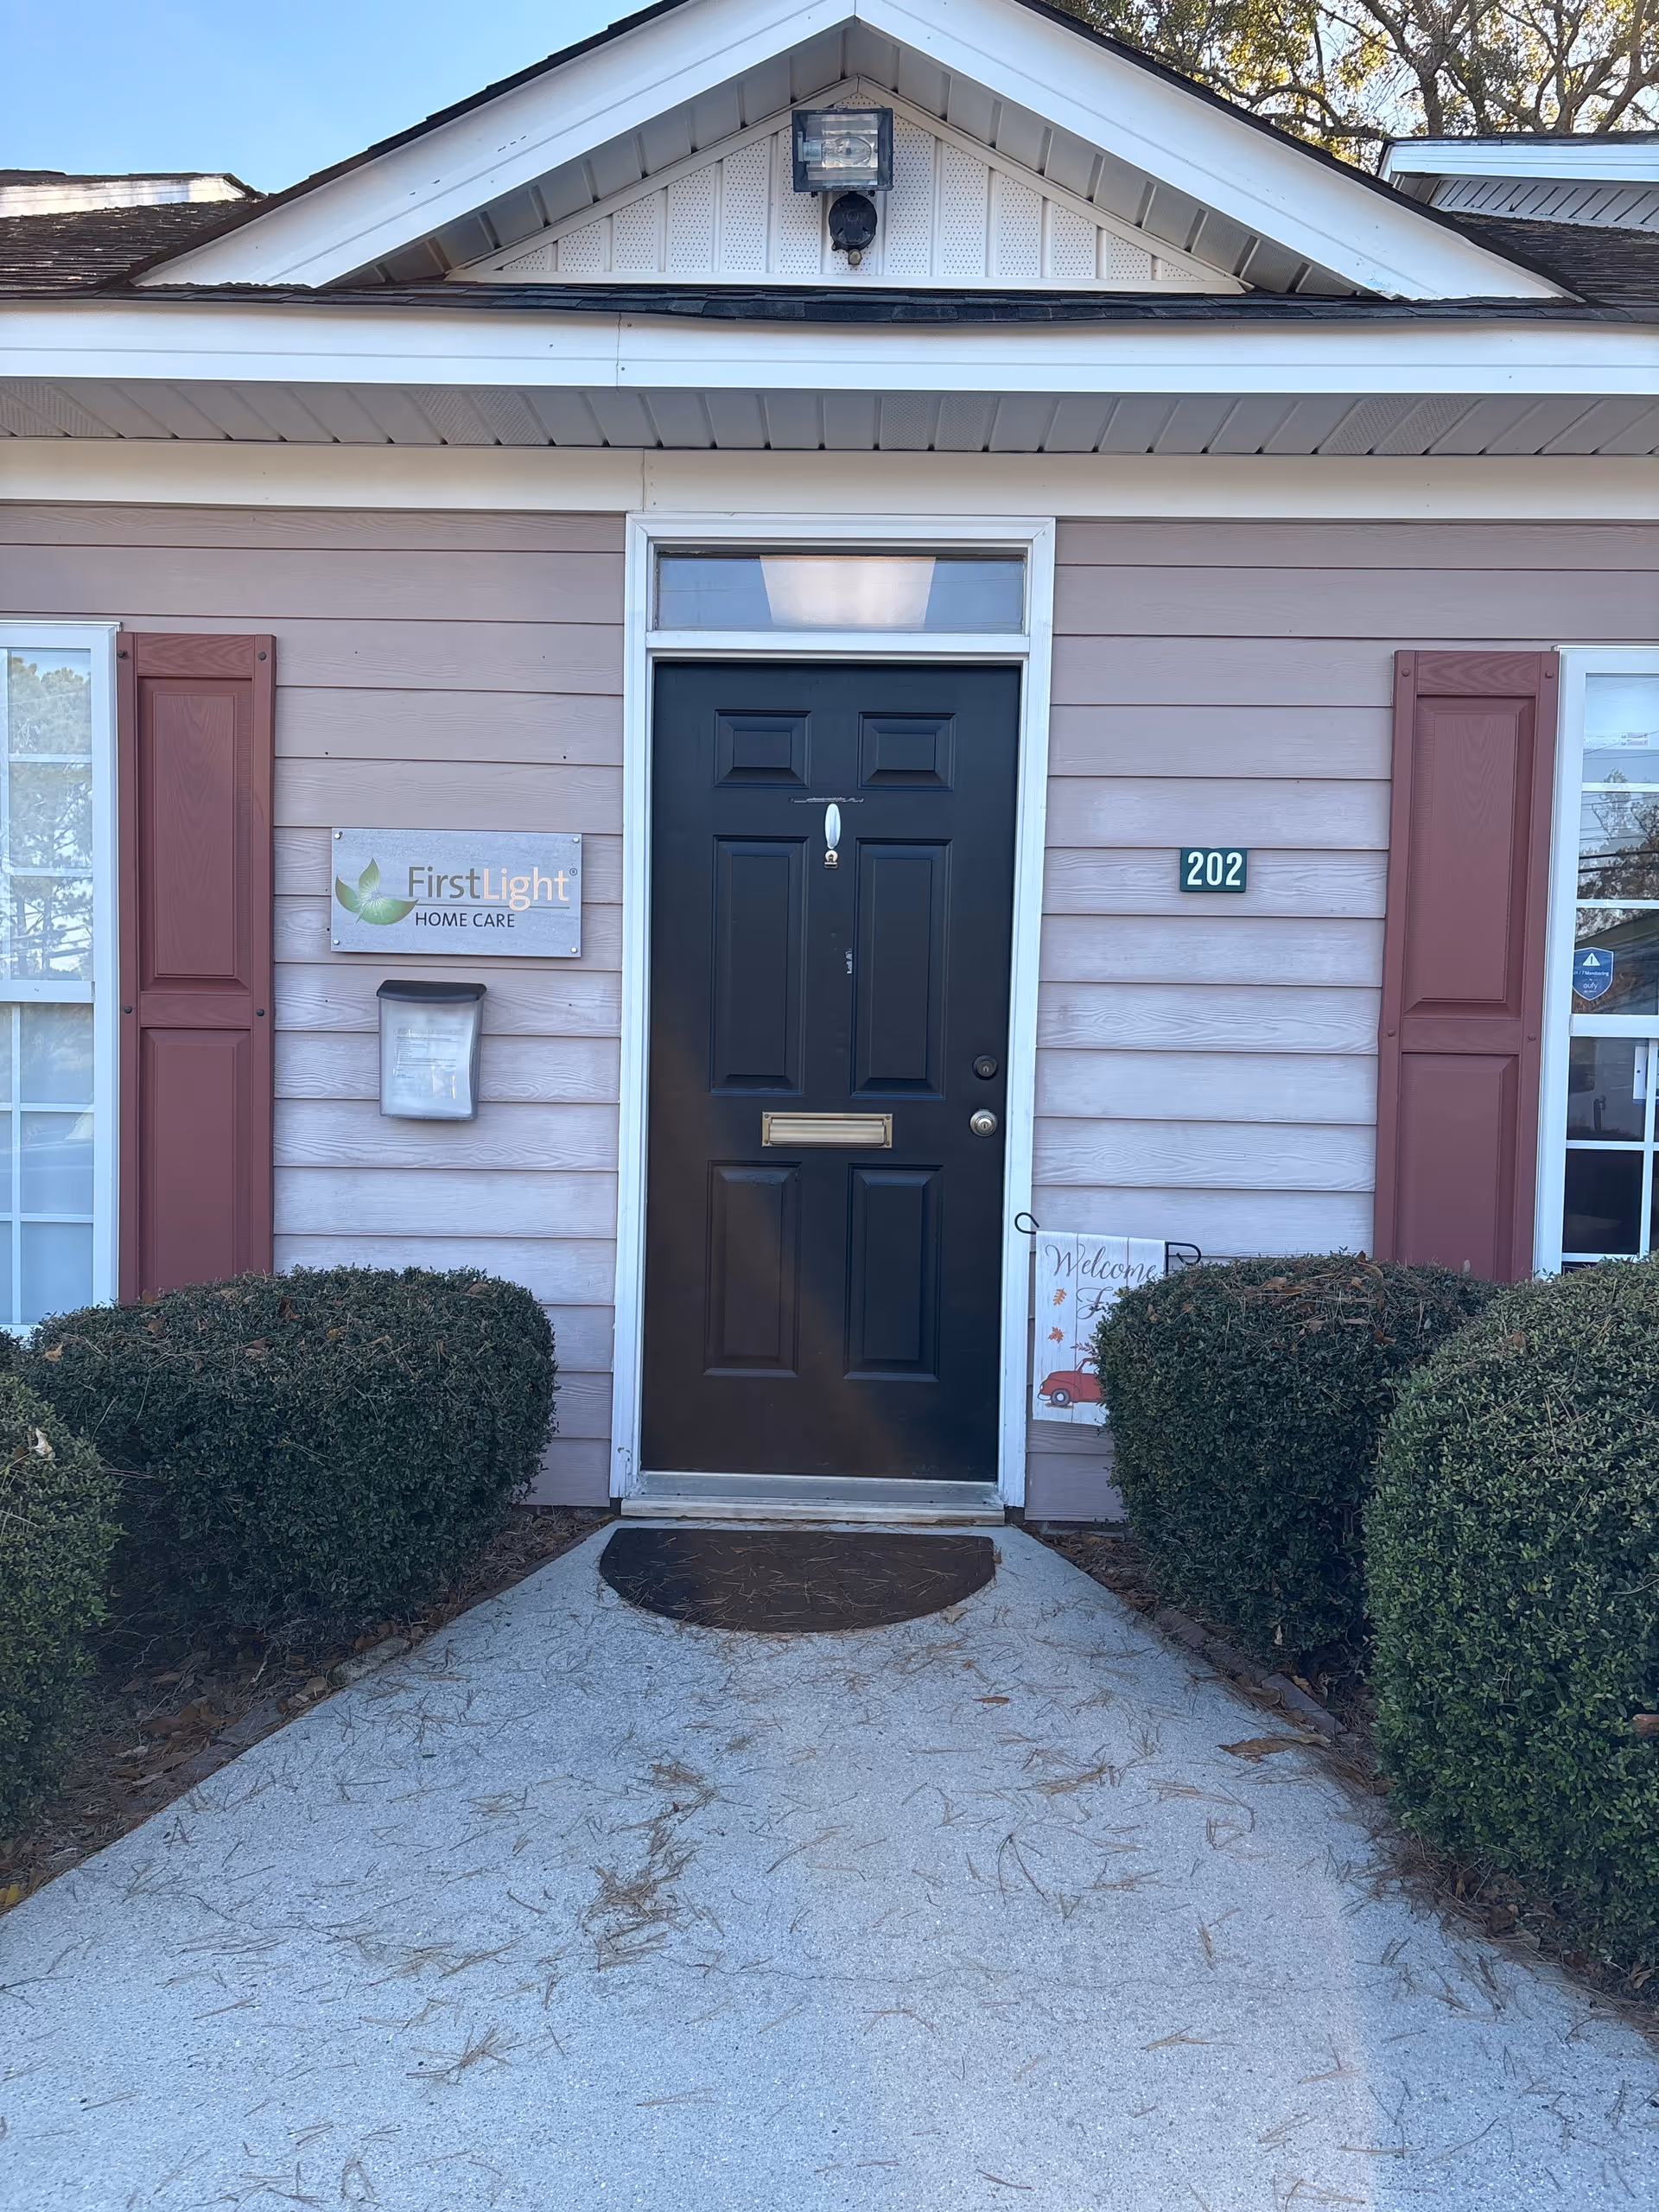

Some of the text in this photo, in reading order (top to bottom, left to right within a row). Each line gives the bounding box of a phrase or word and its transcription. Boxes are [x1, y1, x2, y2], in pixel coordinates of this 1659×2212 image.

[1187, 851, 1243, 886] 202
[415, 912, 515, 928] HOME CARE
[1045, 1243, 1157, 1283] Welcome
